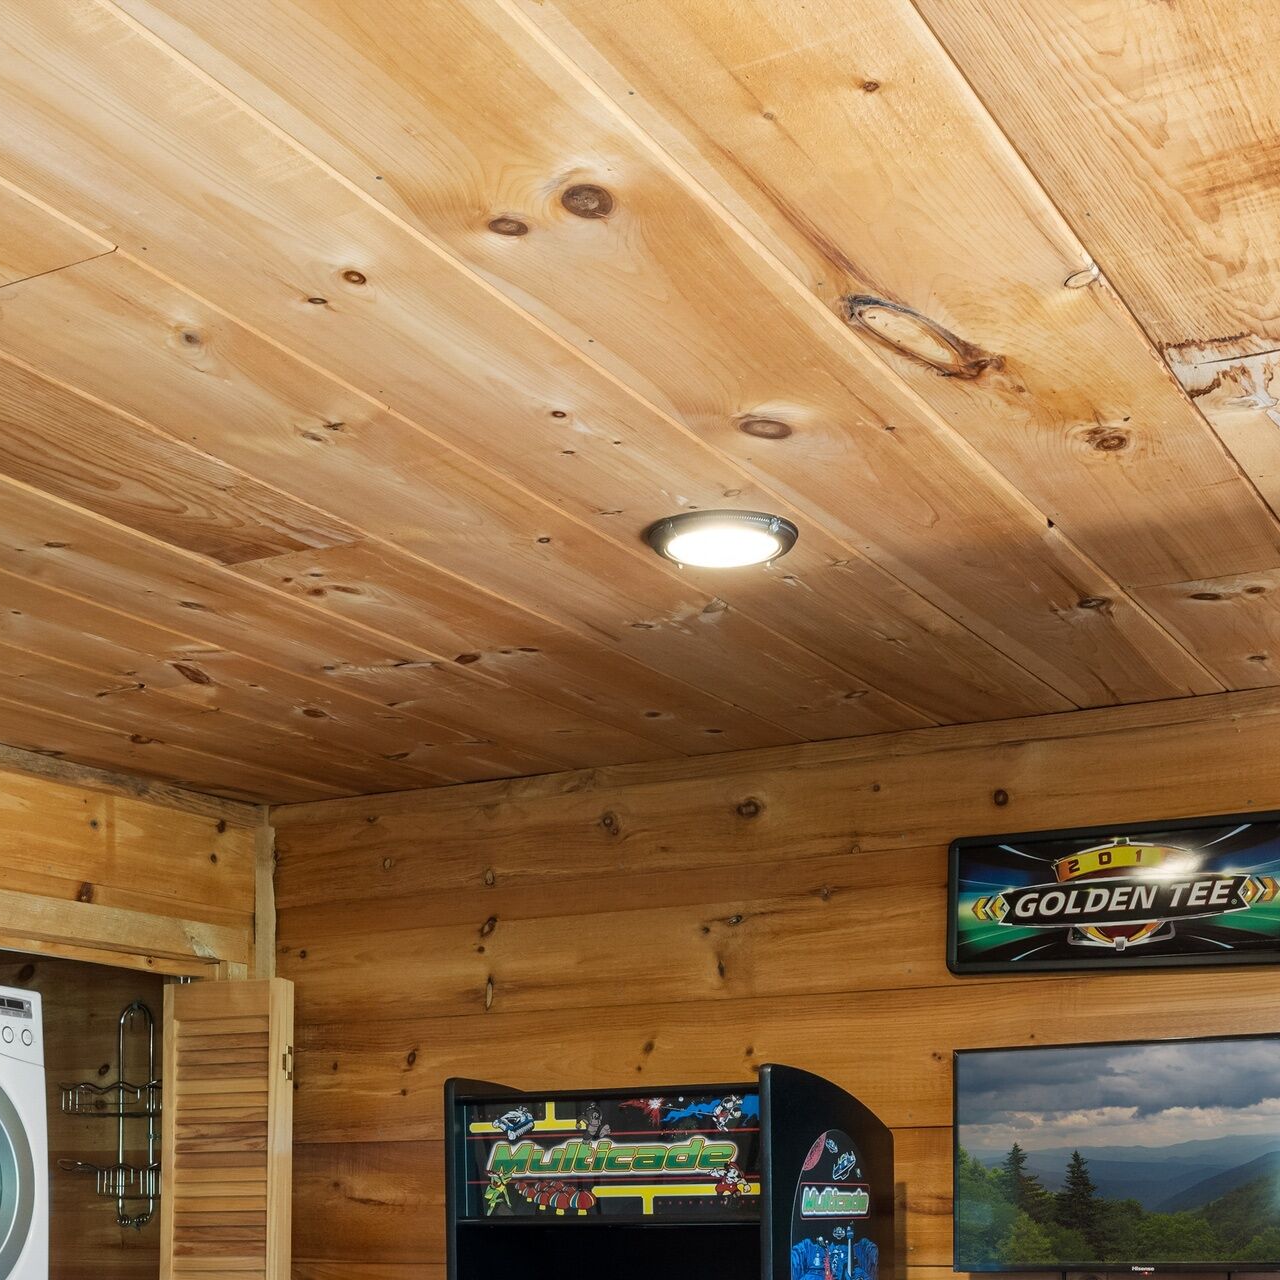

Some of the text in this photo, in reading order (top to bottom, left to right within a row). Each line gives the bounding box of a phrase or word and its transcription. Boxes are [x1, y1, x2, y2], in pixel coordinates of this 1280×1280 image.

[1014, 879, 1234, 919] GOLDEN TEE
[489, 1138, 737, 1175] Multicade
[803, 1188, 869, 1217] Multicade
